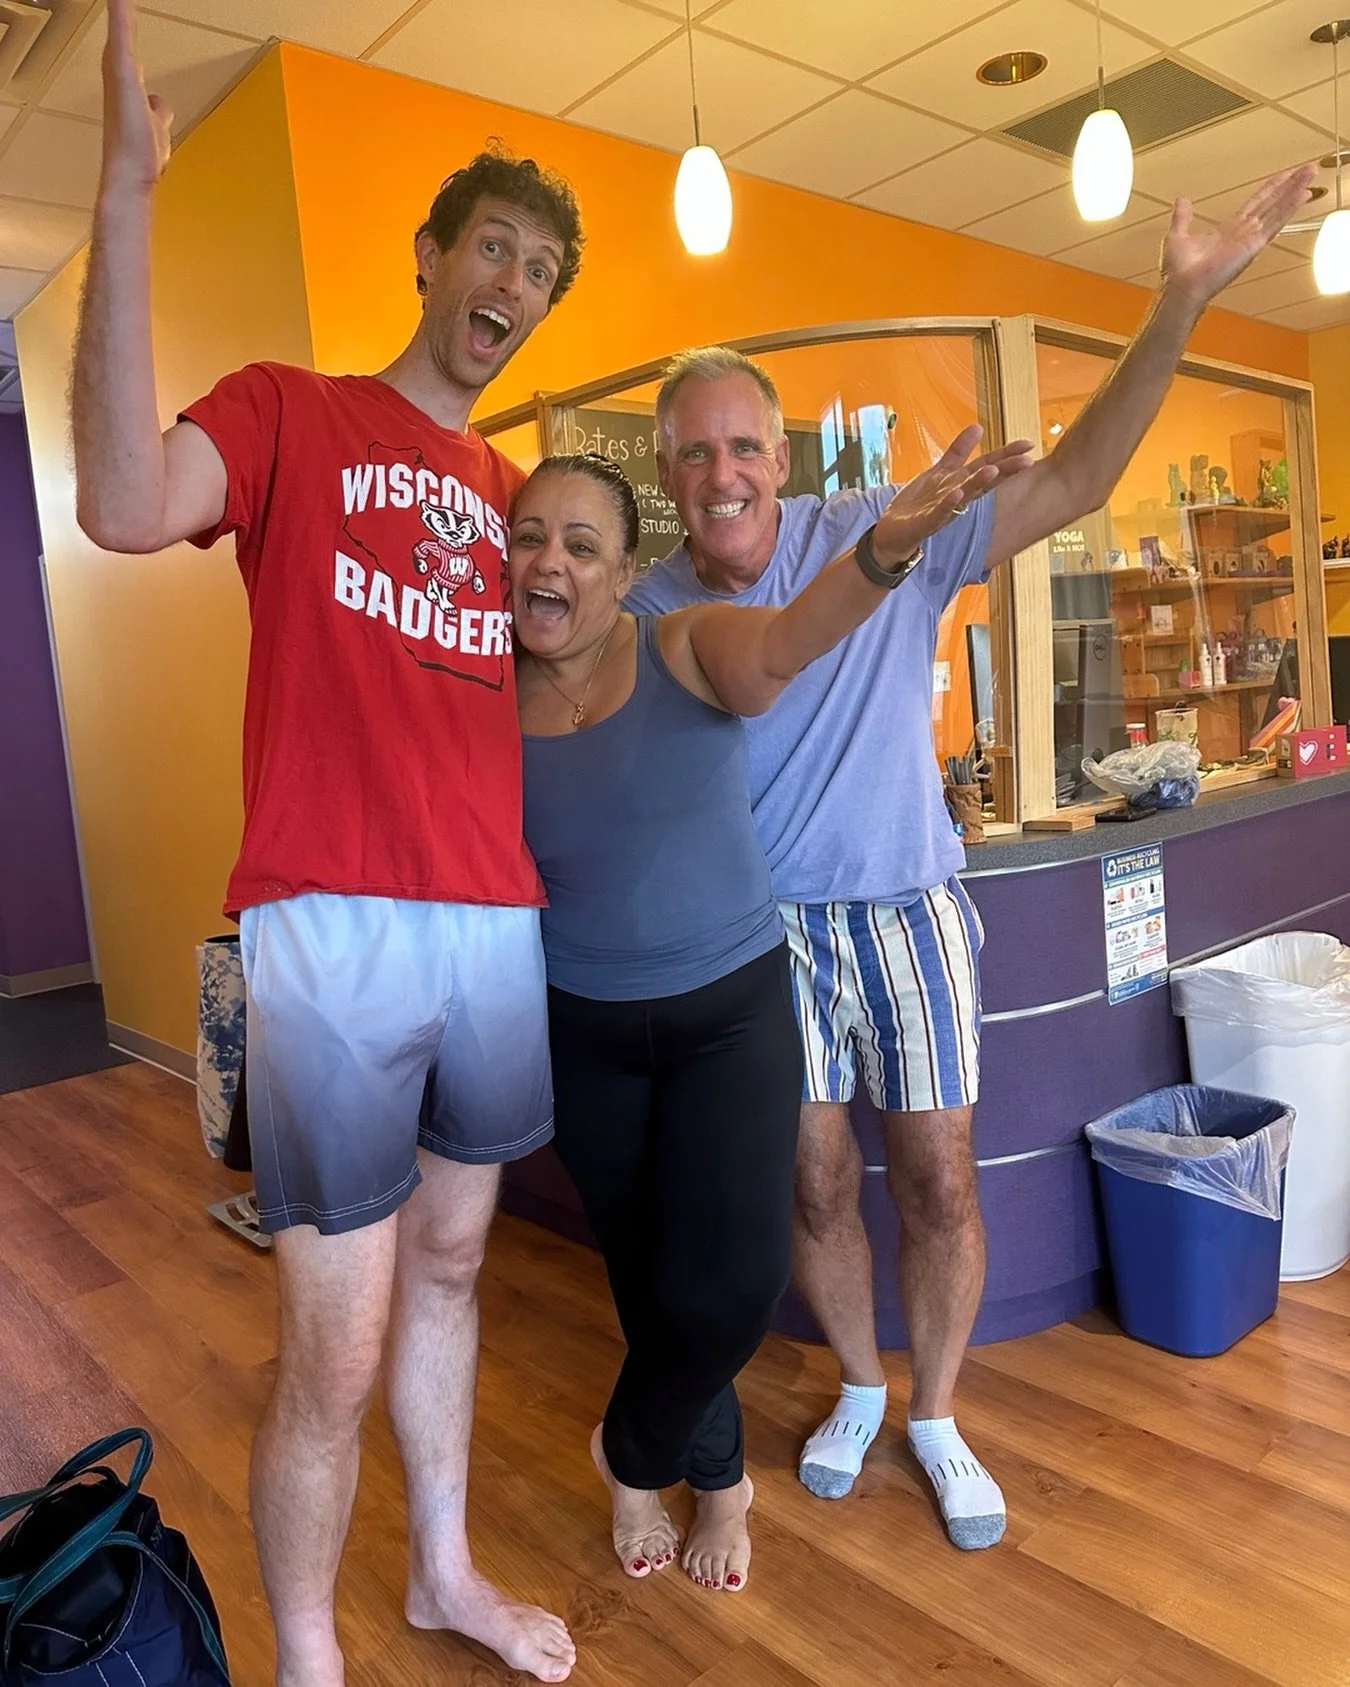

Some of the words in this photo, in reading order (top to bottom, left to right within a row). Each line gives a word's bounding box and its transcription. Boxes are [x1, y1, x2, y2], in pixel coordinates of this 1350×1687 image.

[634, 436, 648, 457] &
[637, 483, 658, 497] NEW
[640, 517, 680, 535] STUDIO
[1053, 530, 1085, 543] YOGA
[449, 556, 469, 576] W
[334, 549, 513, 656] BADGERS
[1117, 862, 1131, 875] IT'S
[1131, 858, 1145, 872] THE
[1145, 854, 1160, 868] LAW
